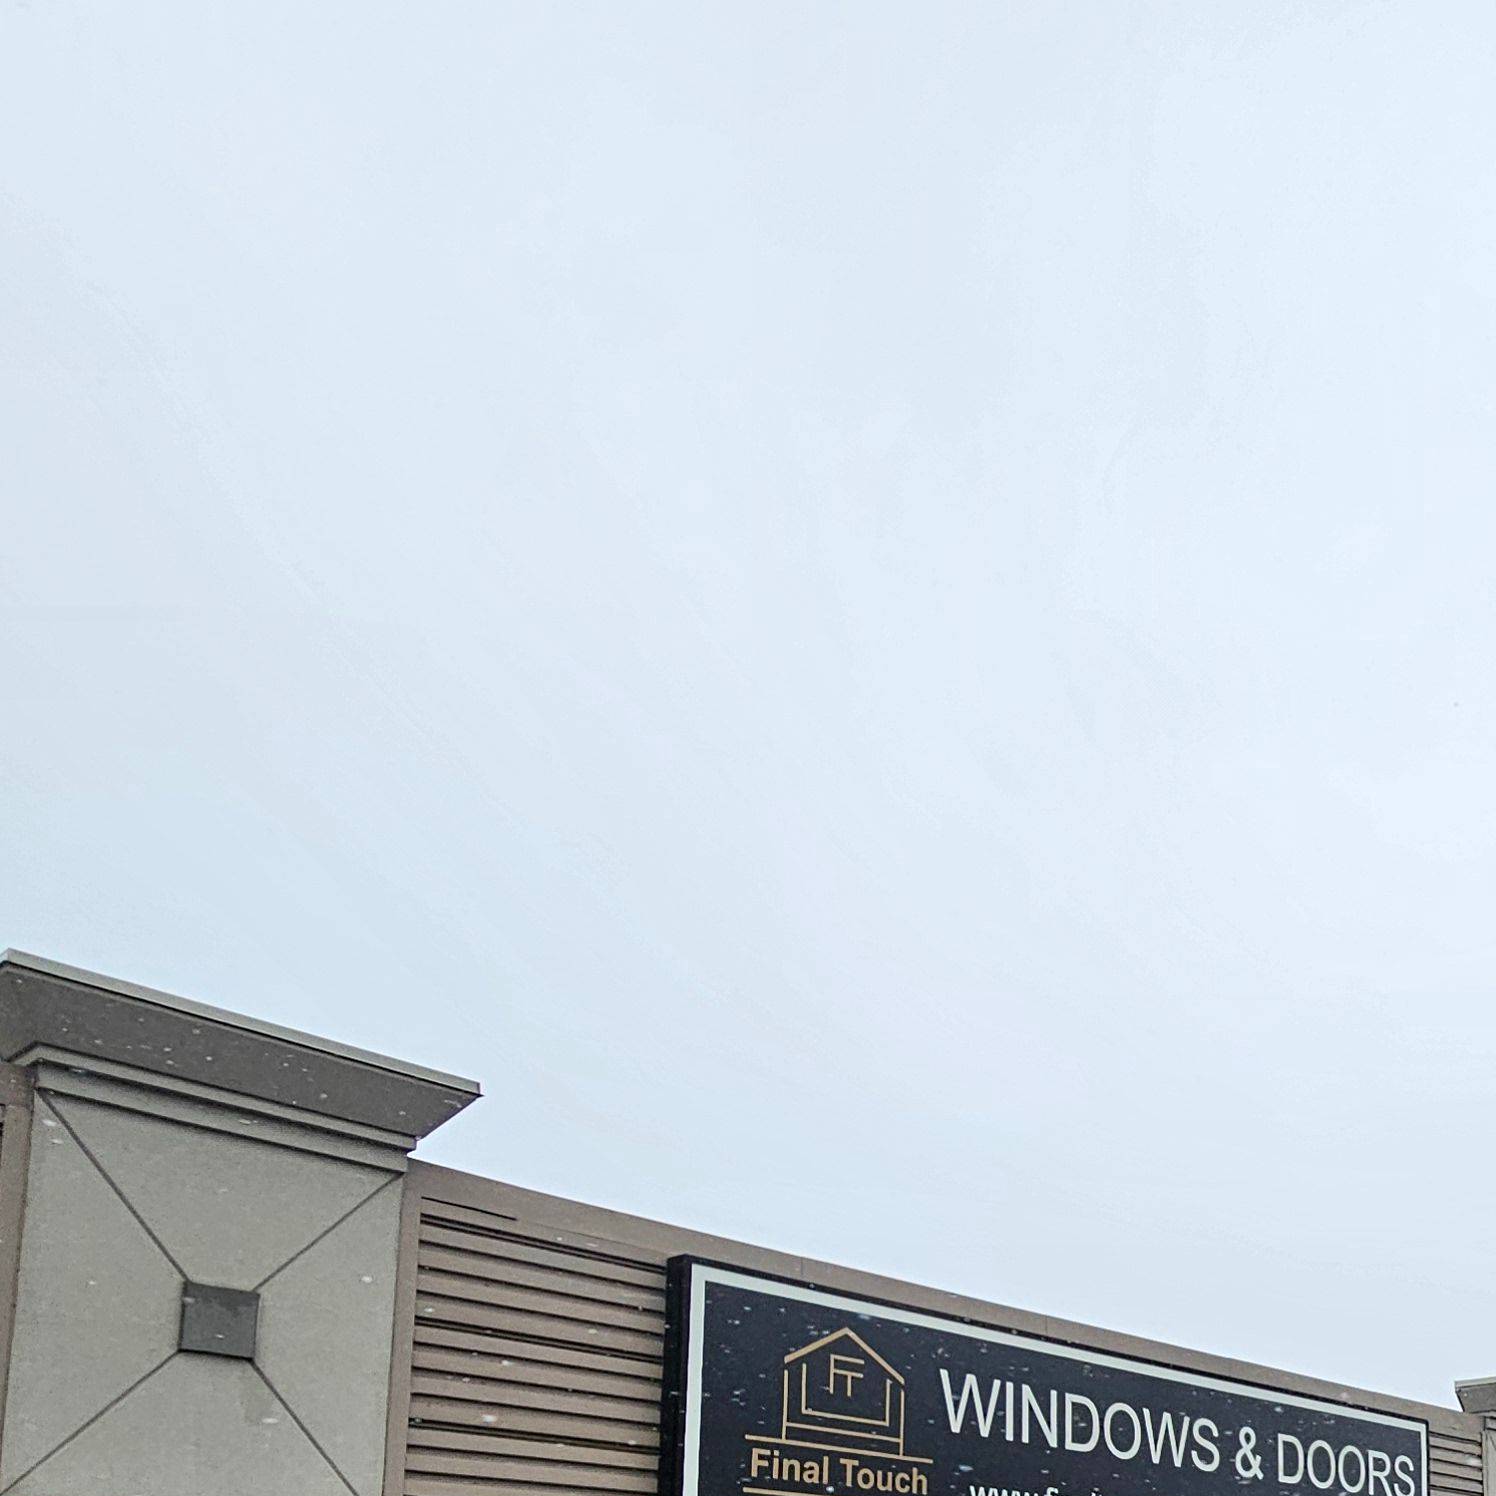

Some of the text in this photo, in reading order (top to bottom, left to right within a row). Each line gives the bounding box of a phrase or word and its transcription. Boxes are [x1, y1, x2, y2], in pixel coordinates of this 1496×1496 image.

[939, 1368, 1221, 1473] WINDOWS
[1235, 1425, 1265, 1481] &
[751, 1447, 928, 1496] Final Touch
